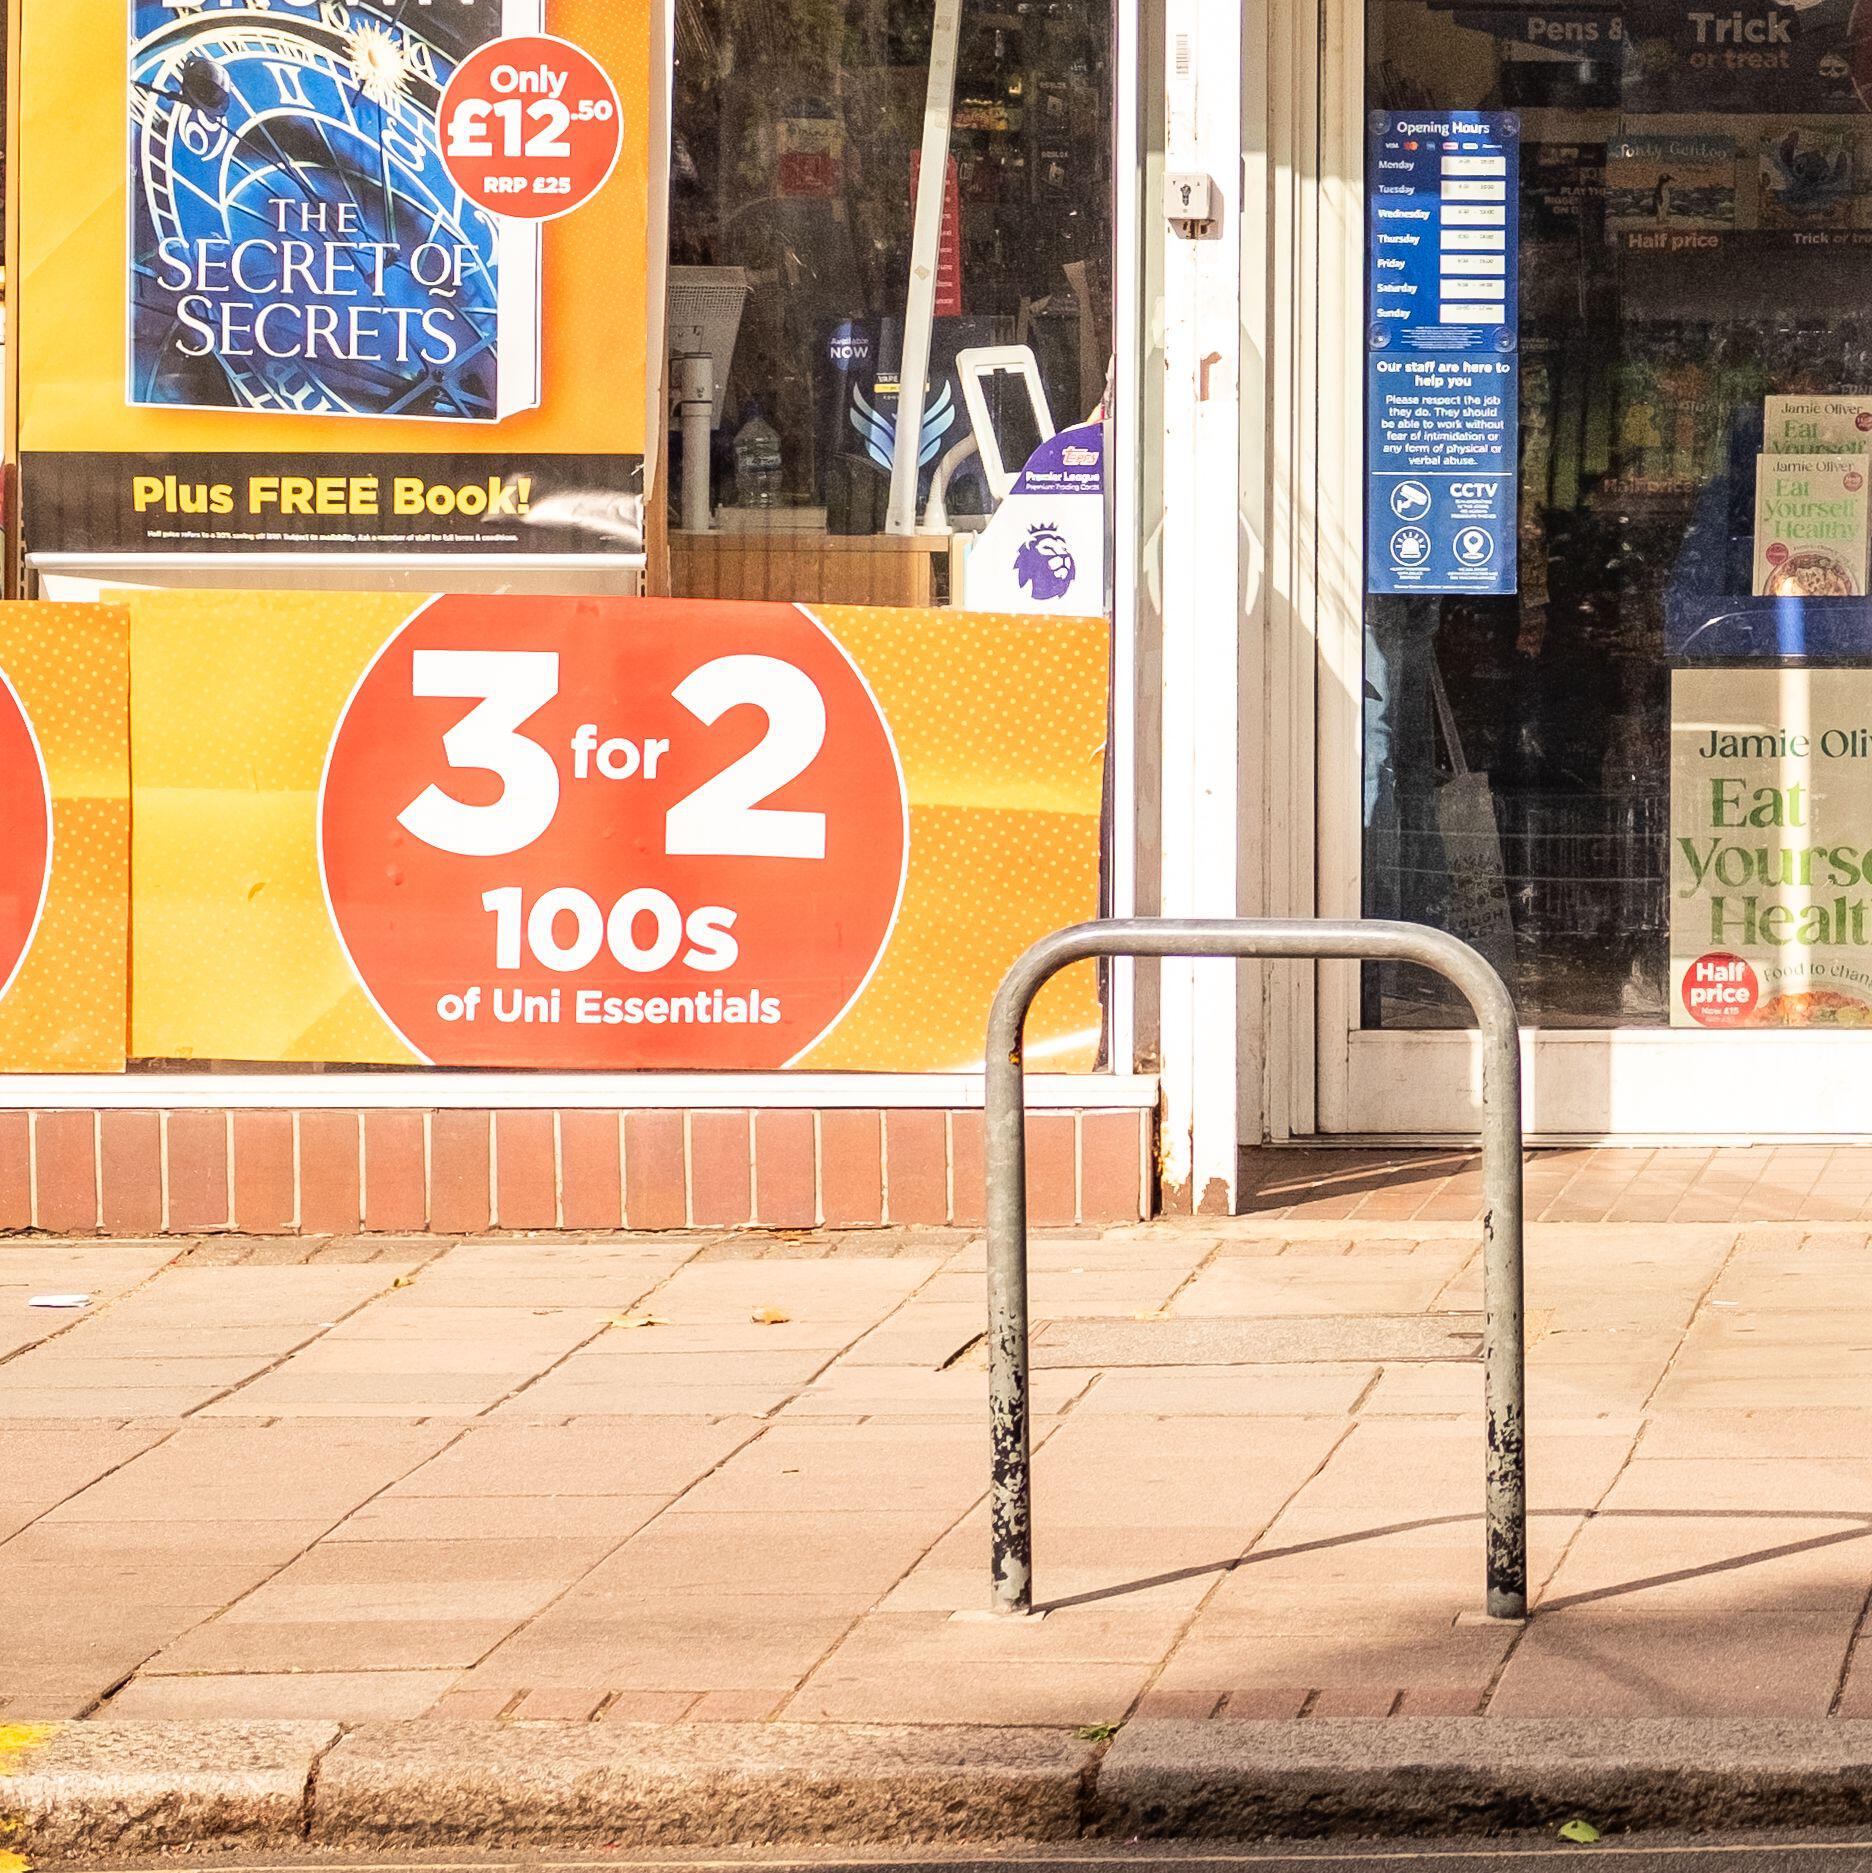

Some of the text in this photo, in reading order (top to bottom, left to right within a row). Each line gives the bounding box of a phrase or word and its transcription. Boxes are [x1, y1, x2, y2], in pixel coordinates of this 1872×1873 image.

[1527, 17, 1599, 41] Pens
[1688, 11, 1792, 44] Trick
[1690, 51, 1790, 70] or treat
[489, 64, 568, 99] Only
[1397, 121, 1490, 137] Opening Hours
[1378, 161, 1415, 171] Monday
[483, 176, 571, 194] RRP £25
[1378, 185, 1415, 196] Tuesday
[268, 198, 358, 233] THE
[1377, 234, 1421, 246] Thursday
[1628, 232, 1719, 251] Half price
[156, 237, 480, 298] SECRET OF
[1377, 259, 1405, 270] Friday
[1376, 283, 1418, 295] Saturday
[1376, 308, 1411, 320] Sunday
[175, 295, 458, 365] SECRETS
[830, 346, 869, 359] NOW
[1377, 360, 1510, 373] Our staff are here to
[1414, 375, 1472, 388] help you
[1064, 472, 1100, 483] League
[133, 476, 533, 516] Plus FREE Book!
[1449, 483, 1498, 498] CCTV
[1699, 729, 1810, 758] Jamie
[397, 649, 826, 859] 3 for 2
[1710, 778, 1807, 828] Eat
[482, 887, 739, 973] 100s
[1696, 962, 1747, 982] Half
[1689, 984, 1750, 1007] price
[437, 987, 781, 1026] of Uni Essentials
